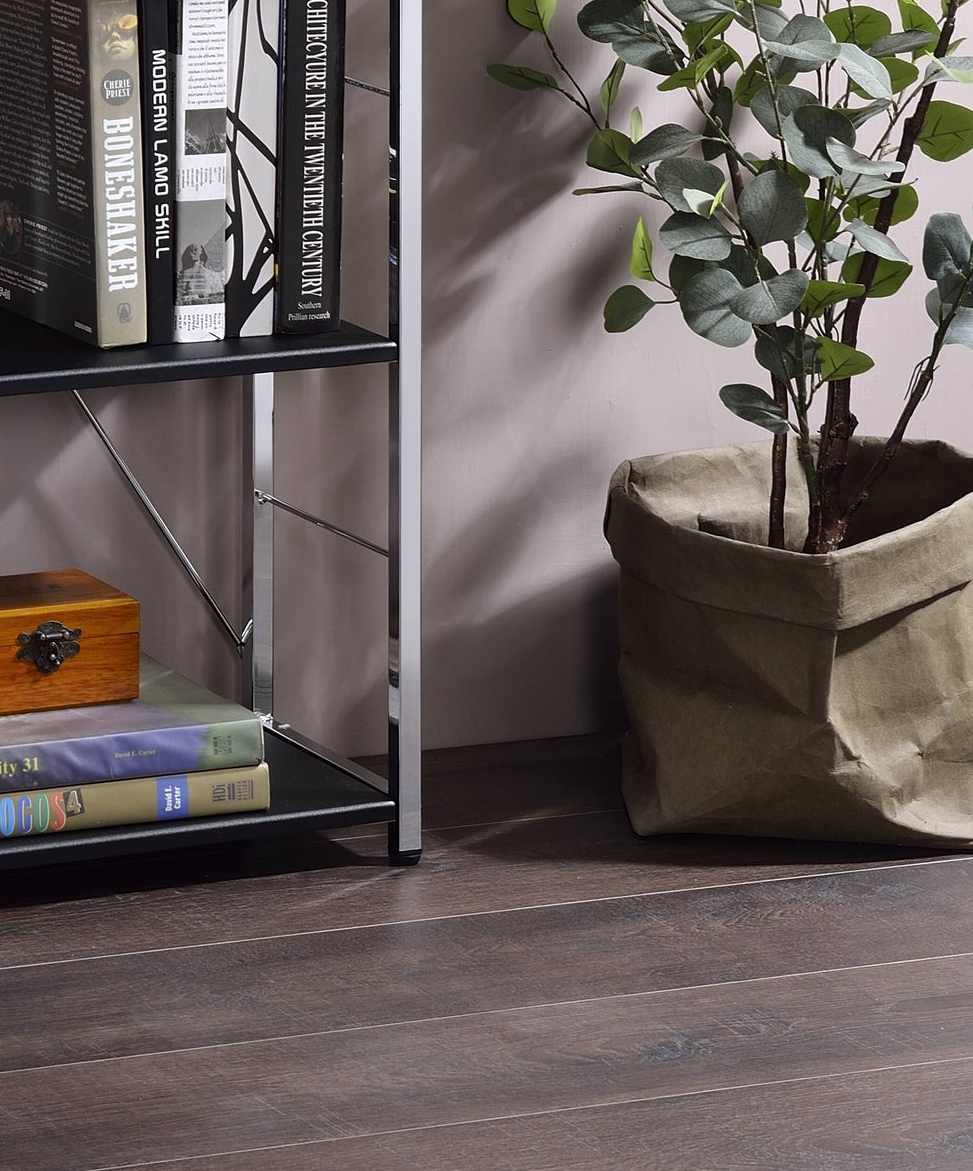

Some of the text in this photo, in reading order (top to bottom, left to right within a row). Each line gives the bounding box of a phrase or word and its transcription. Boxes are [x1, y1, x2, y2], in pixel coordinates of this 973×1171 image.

[103, 78, 132, 90] CHERIE
[105, 88, 131, 100] PRIEST
[305, 93, 326, 109] IN
[304, 111, 326, 141] THE
[153, 139, 169, 196] LAMO
[303, 142, 325, 228] TWENTIETH
[103, 115, 139, 293] BONESHAKER
[155, 203, 171, 259] SKILL
[301, 230, 325, 297] CENTURY
[297, 301, 323, 310] Southern
[308, 310, 331, 320] research
[22, 756, 40, 773] 31
[114, 750, 131, 759] David
[65, 789, 83, 815] 4
[164, 785, 173, 812] David E.
[173, 786, 182, 810] Carter
